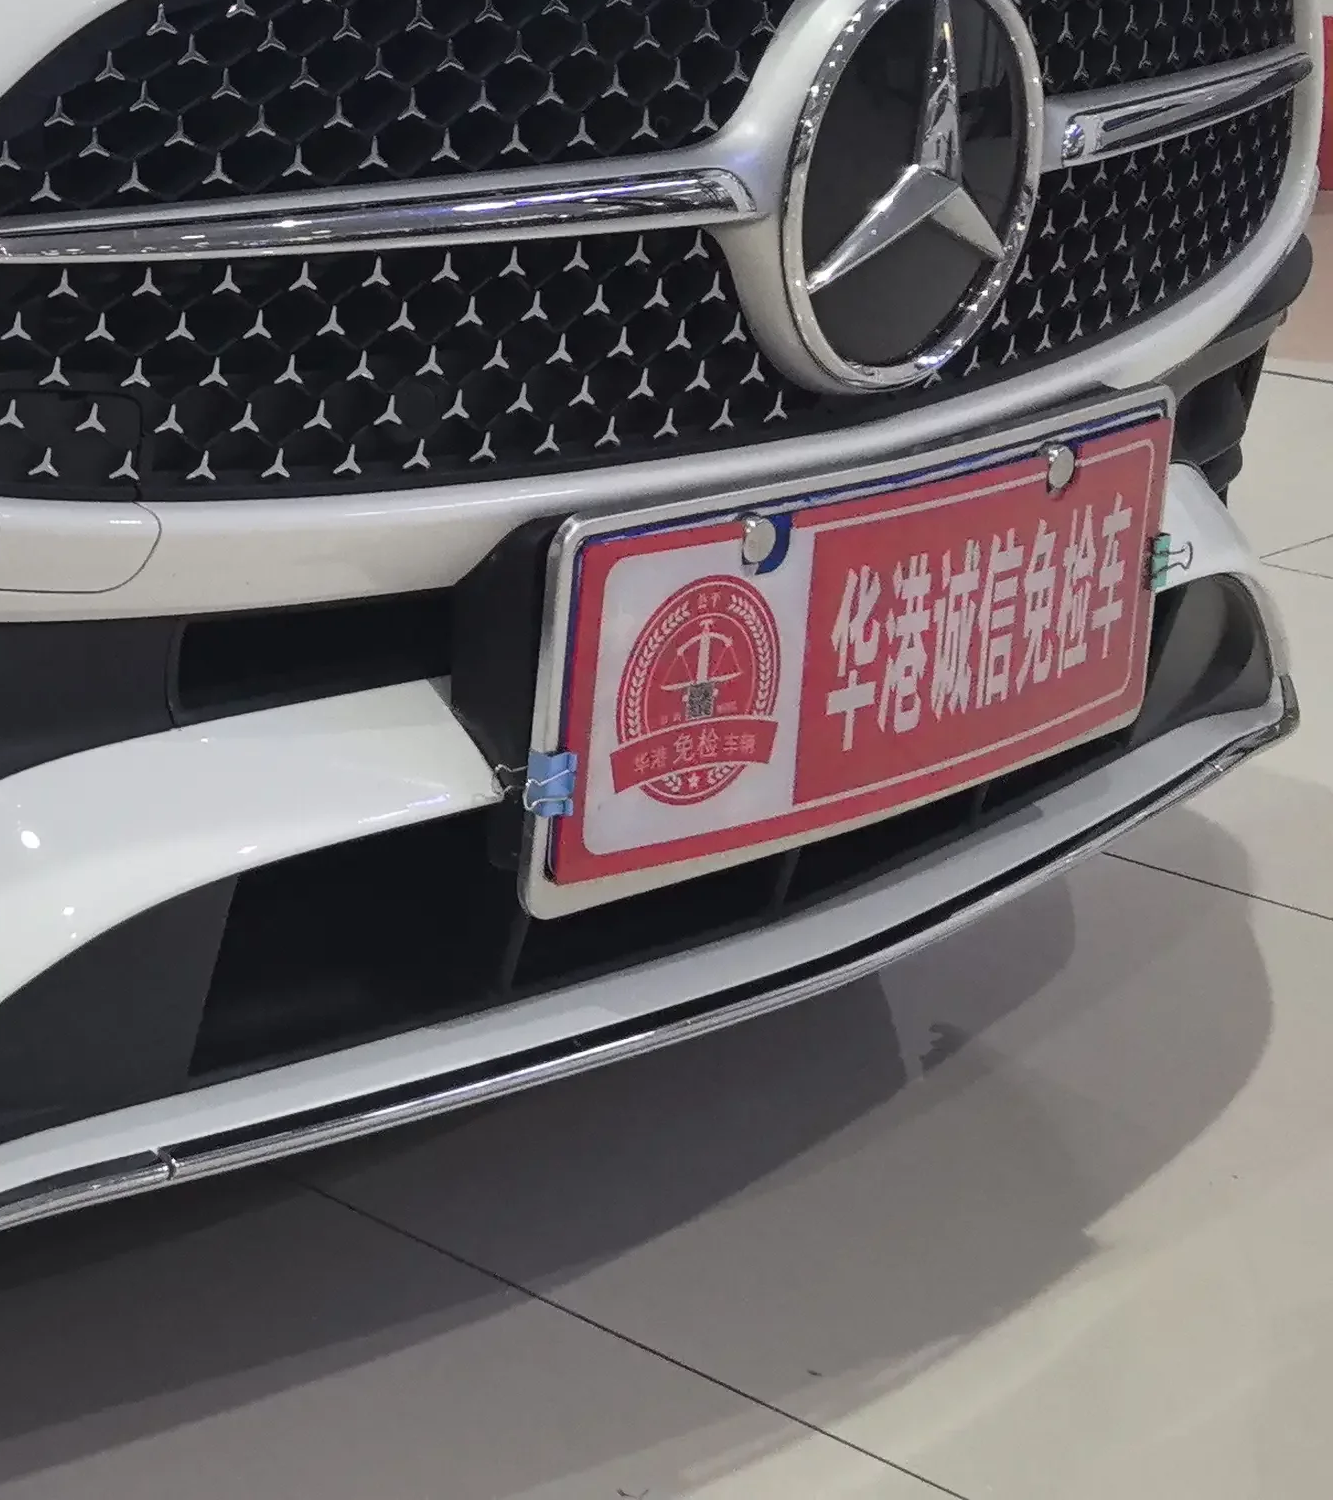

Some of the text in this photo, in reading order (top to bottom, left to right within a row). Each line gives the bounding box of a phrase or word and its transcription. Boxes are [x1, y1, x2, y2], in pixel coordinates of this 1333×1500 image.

[826, 492, 1132, 751] 华港诚信免检车
